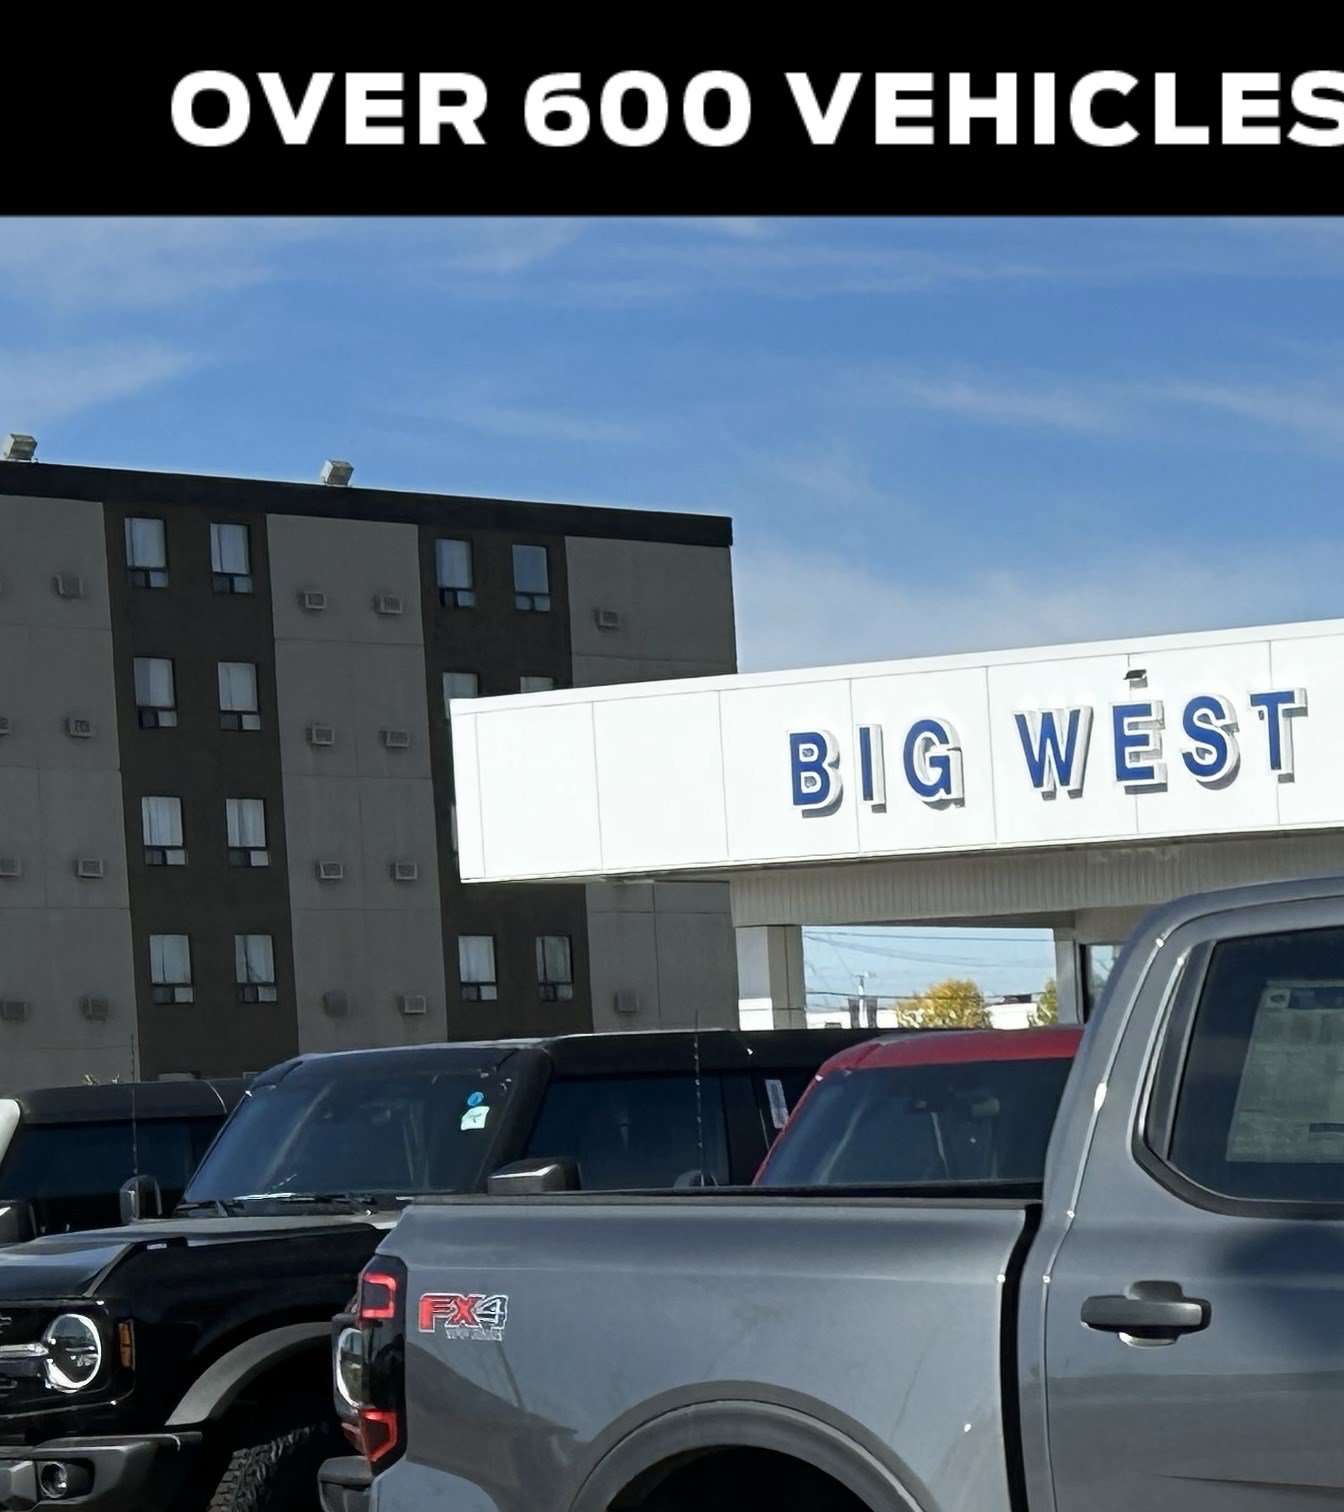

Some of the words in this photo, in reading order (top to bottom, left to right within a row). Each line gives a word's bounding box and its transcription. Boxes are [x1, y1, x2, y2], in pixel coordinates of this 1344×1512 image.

[788, 715, 962, 814] BIG
[1013, 688, 1304, 796] WEST
[418, 1292, 509, 1333] FX4
